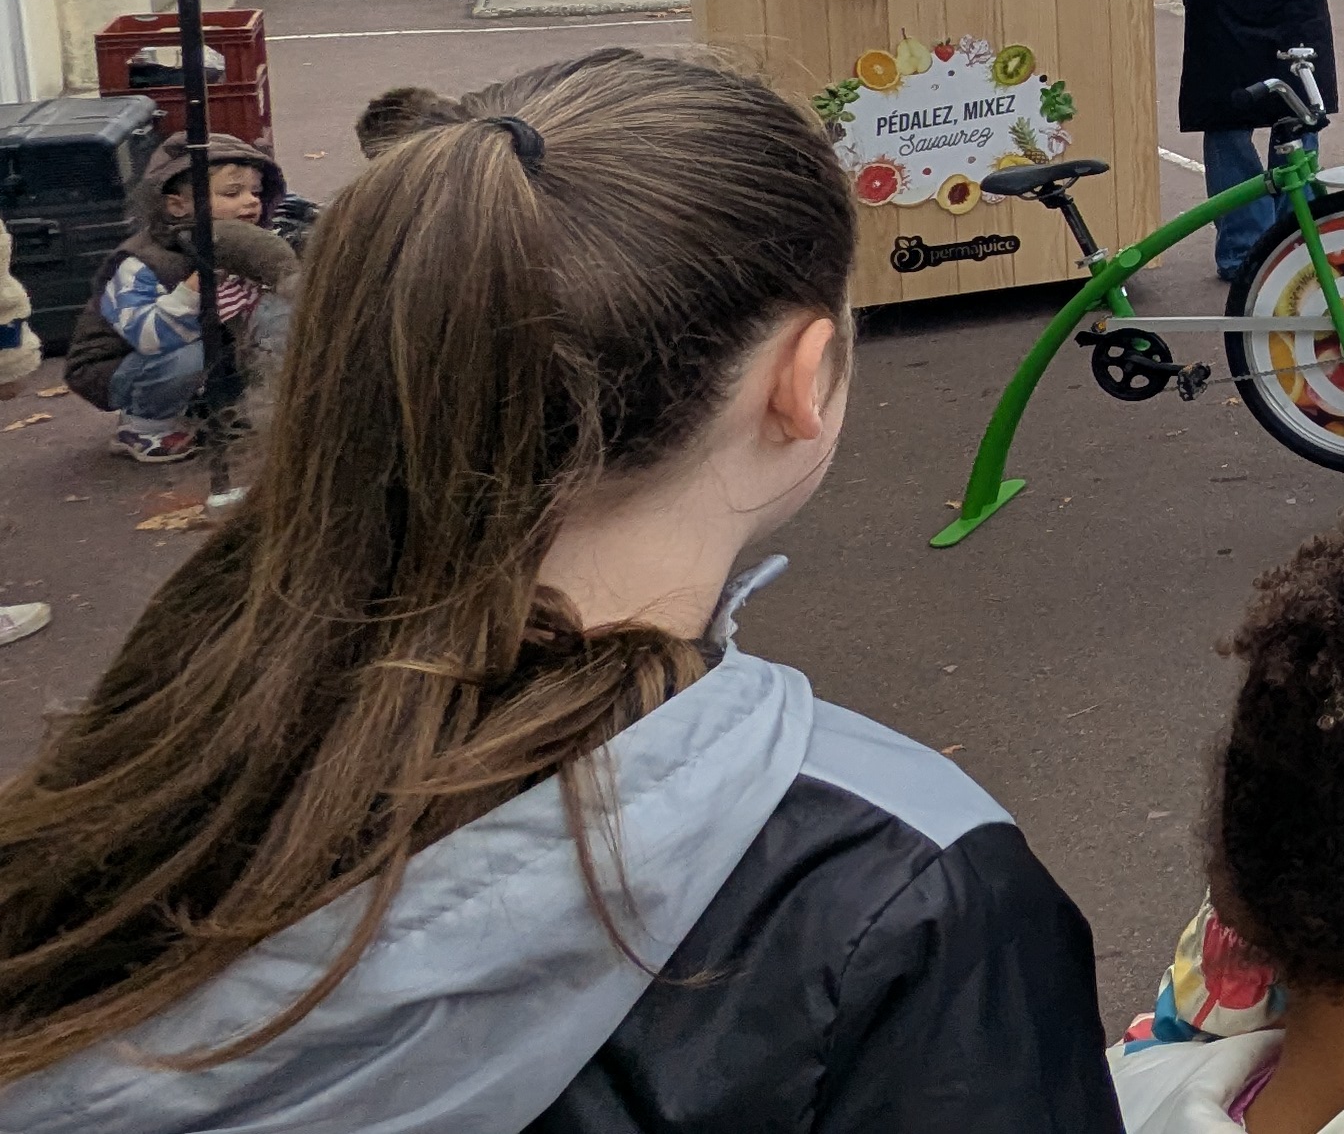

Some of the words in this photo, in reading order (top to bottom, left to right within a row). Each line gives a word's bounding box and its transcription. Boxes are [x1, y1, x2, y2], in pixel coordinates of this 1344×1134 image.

[876, 105, 958, 136] PÉDALEZ,
[963, 94, 1016, 121] MIXEZ
[899, 127, 994, 156] Savourez
[930, 239, 1015, 263] permajuice
